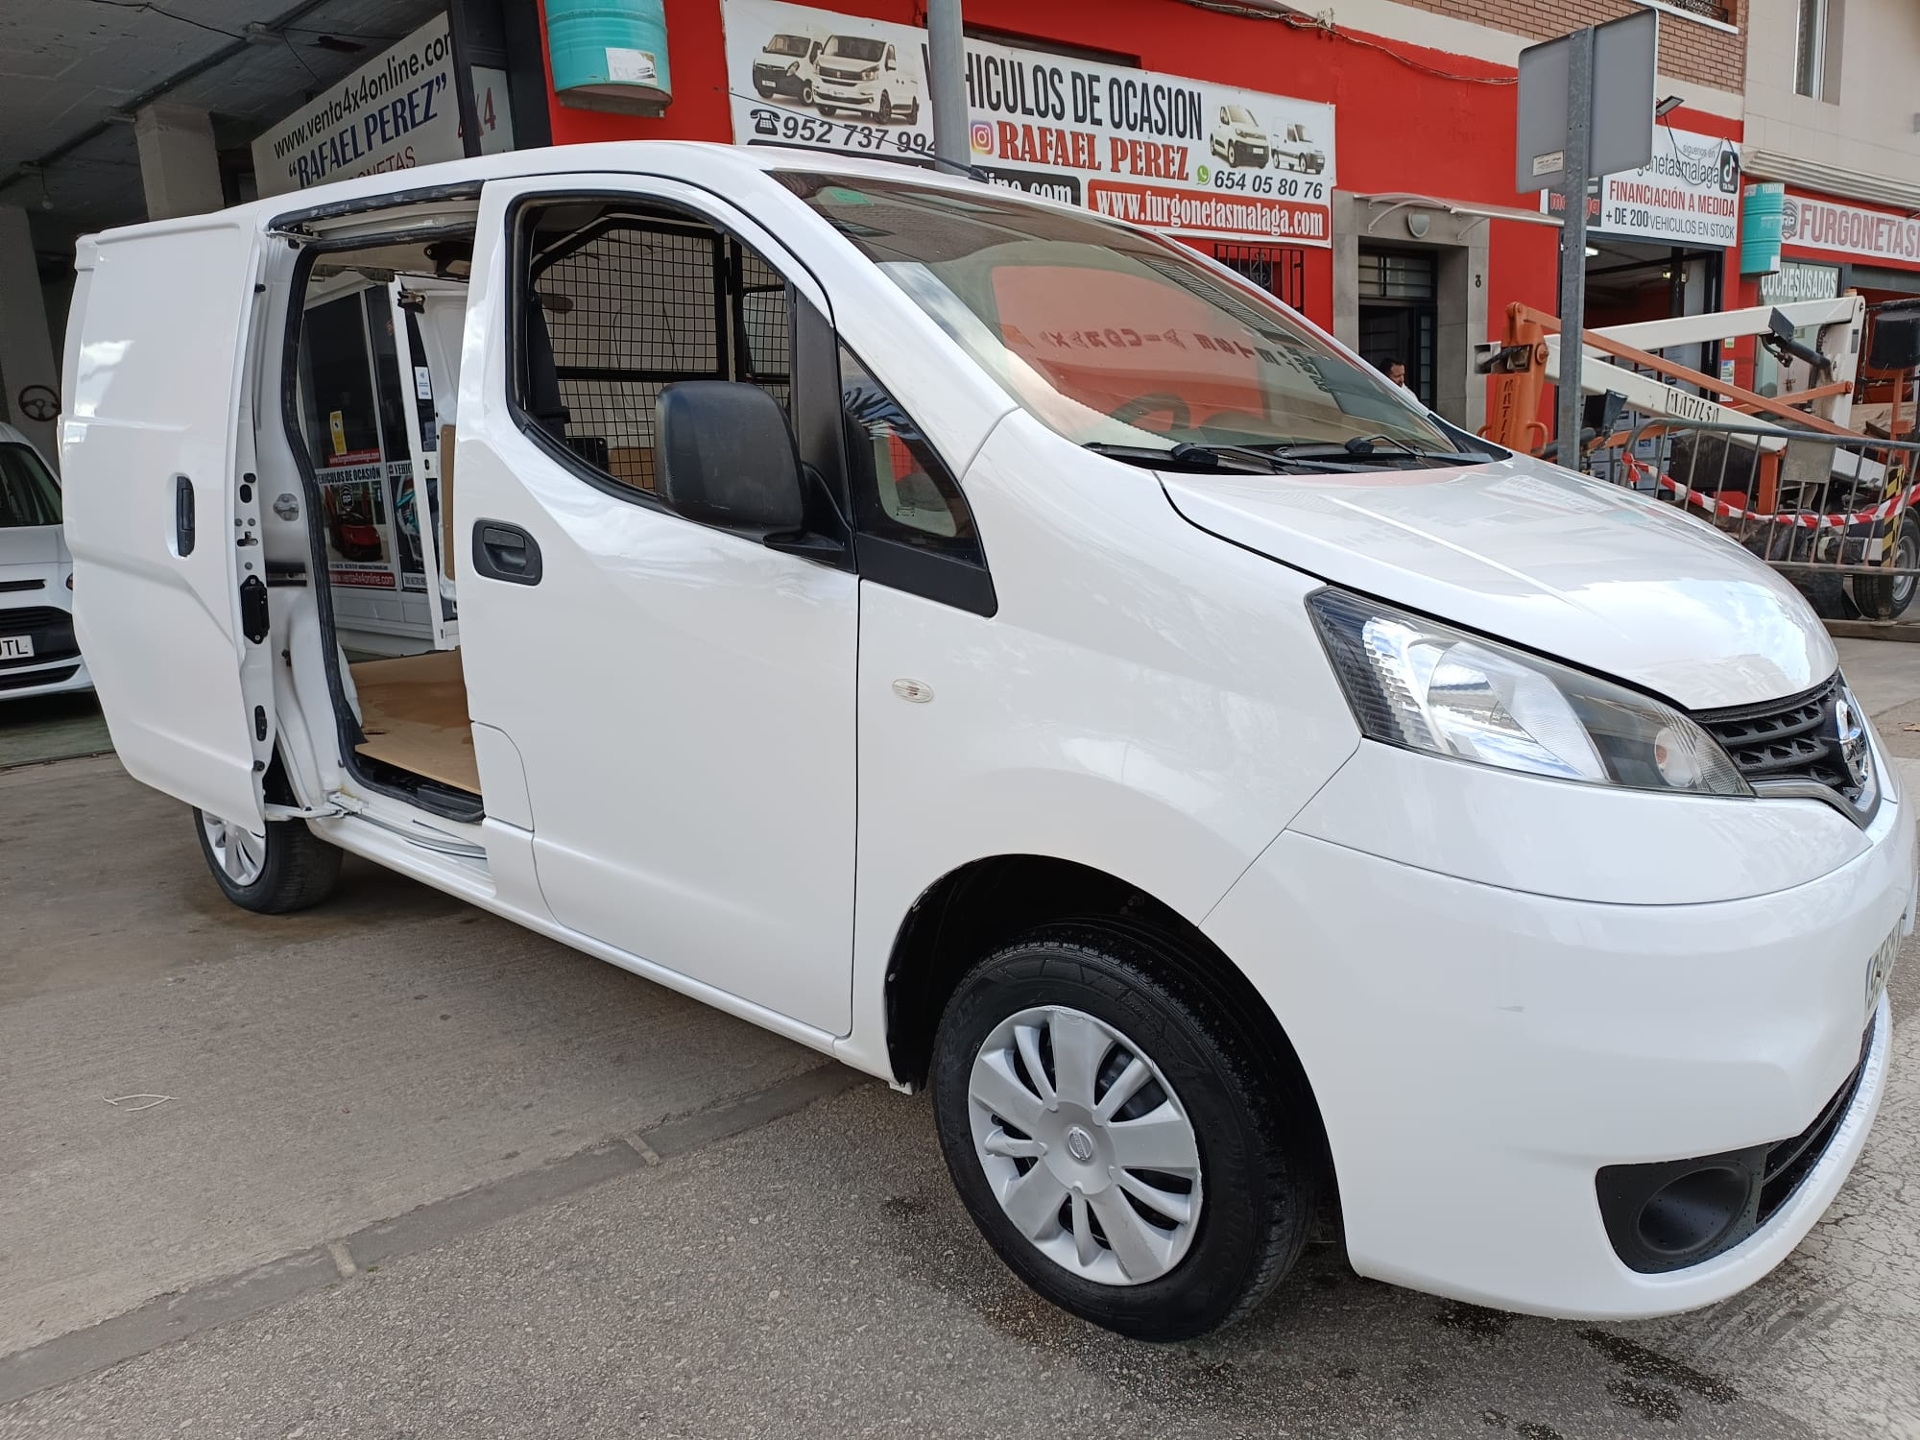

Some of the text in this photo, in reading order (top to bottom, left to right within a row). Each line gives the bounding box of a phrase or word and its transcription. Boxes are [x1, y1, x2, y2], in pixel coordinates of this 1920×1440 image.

[1071, 70, 1102, 126] DE
[1109, 77, 1202, 141] OCASION
[783, 115, 833, 144] 952
[843, 123, 889, 150] 737
[996, 119, 1190, 181] RAFAEL PEREZ
[1214, 170, 1323, 200] 654 05 80 76
[1609, 180, 1735, 218] FINANCIACIÓN A MEDIDA
[1095, 189, 1324, 237] www.furgonetasmalaga.com
[1614, 207, 1627, 225] DE
[1630, 208, 1649, 228] 200
[1698, 221, 1709, 236] EN
[1710, 222, 1735, 239] STOCK
[1761, 268, 1836, 300] COCHES USADOS
[0, 640, 28, 656] TL
